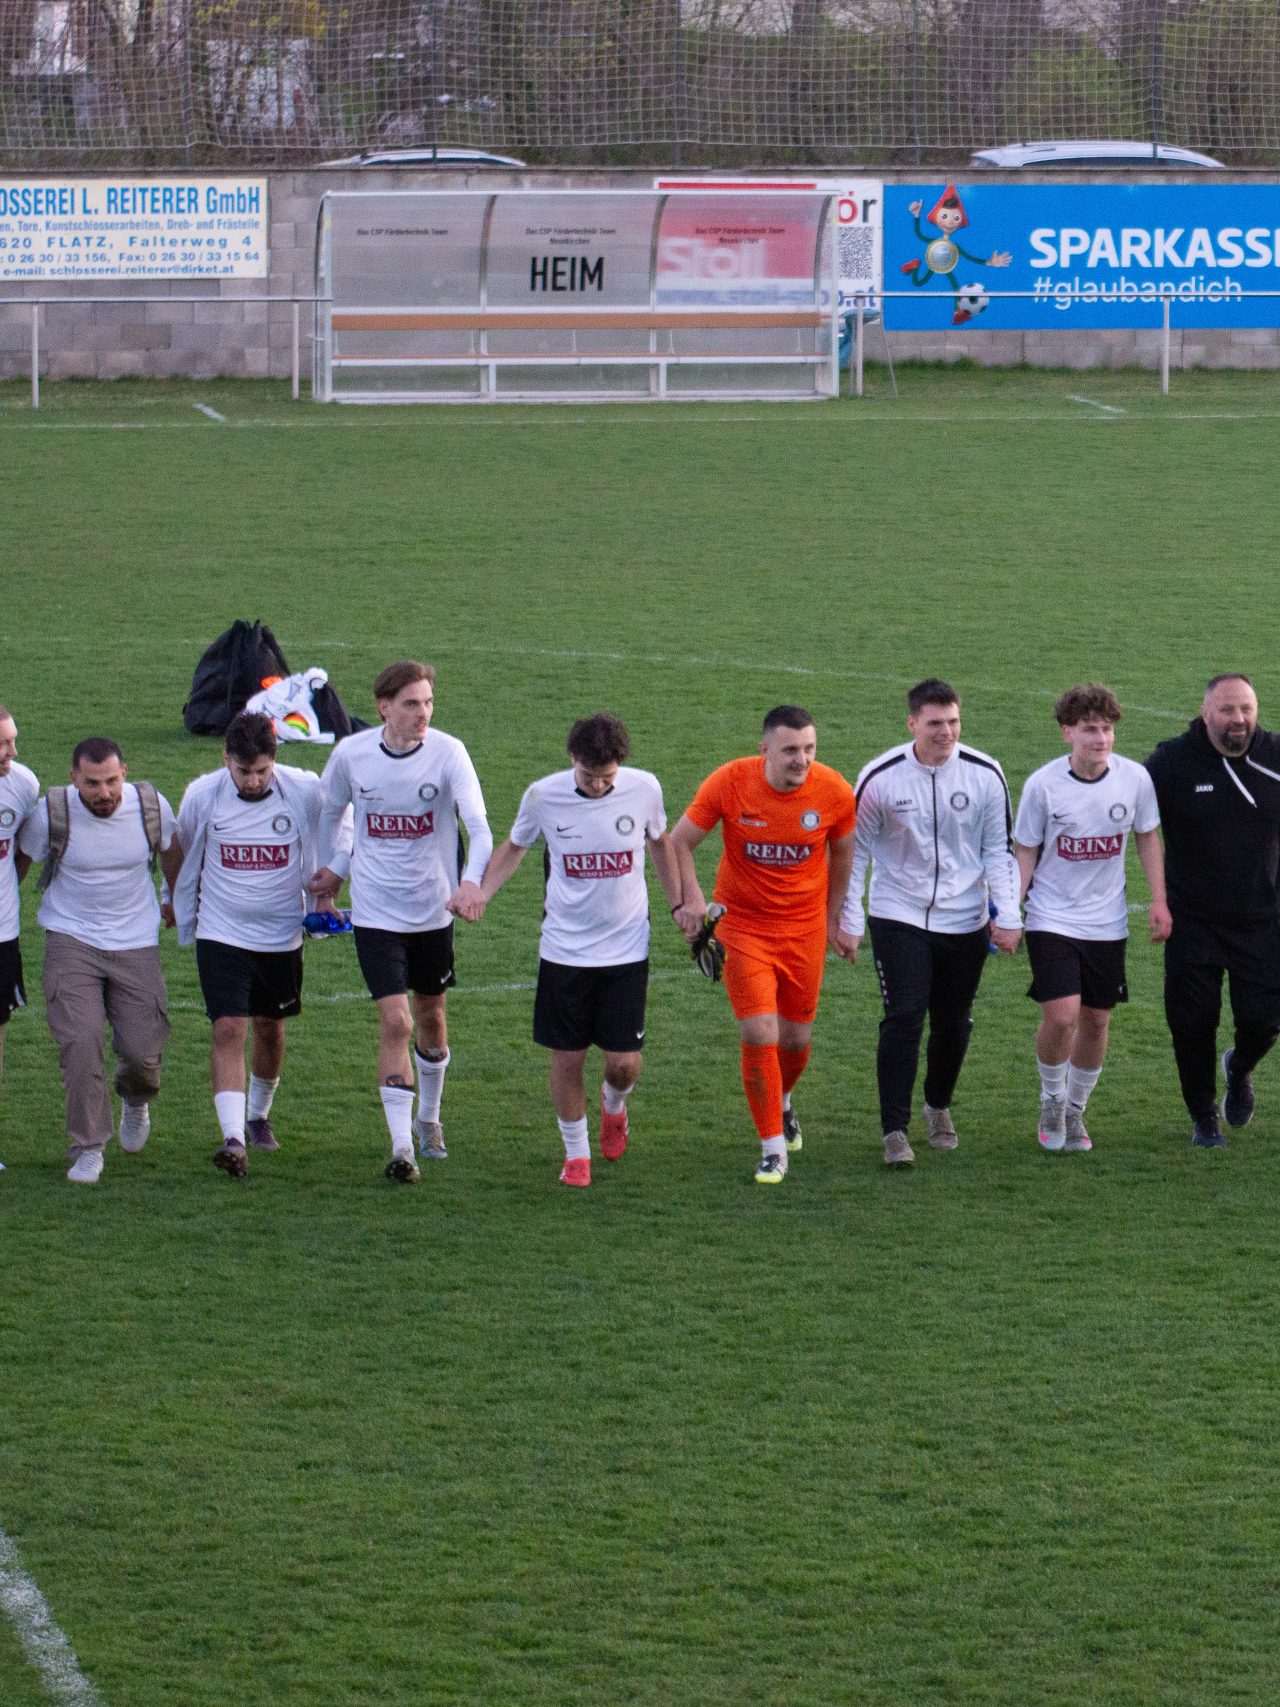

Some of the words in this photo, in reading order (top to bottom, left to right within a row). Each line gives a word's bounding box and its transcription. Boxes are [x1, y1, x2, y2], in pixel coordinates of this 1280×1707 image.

[82, 187, 99, 214] L.
[106, 187, 198, 214] REITERER
[206, 186, 259, 213] GmbH
[47, 237, 113, 249] FLATZ,
[128, 236, 228, 249] Falterweg
[243, 235, 252, 246] 4
[20, 254, 35, 262] 26
[39, 253, 54, 262] 30
[65, 253, 80, 262] 33
[119, 252, 145, 262] Fax:
[149, 252, 157, 261] 0
[180, 252, 196, 261] 30
[207, 252, 221, 261] 33
[245, 251, 259, 261] 64
[3, 265, 45, 276] e-mail:
[530, 256, 604, 292] HEIM
[1033, 276, 1243, 310] #glaubandich
[367, 815, 431, 831] REINA
[747, 842, 810, 859] REINA
[1060, 836, 1118, 853] REINA
[223, 847, 287, 862] REINA
[566, 853, 631, 871] REINA
